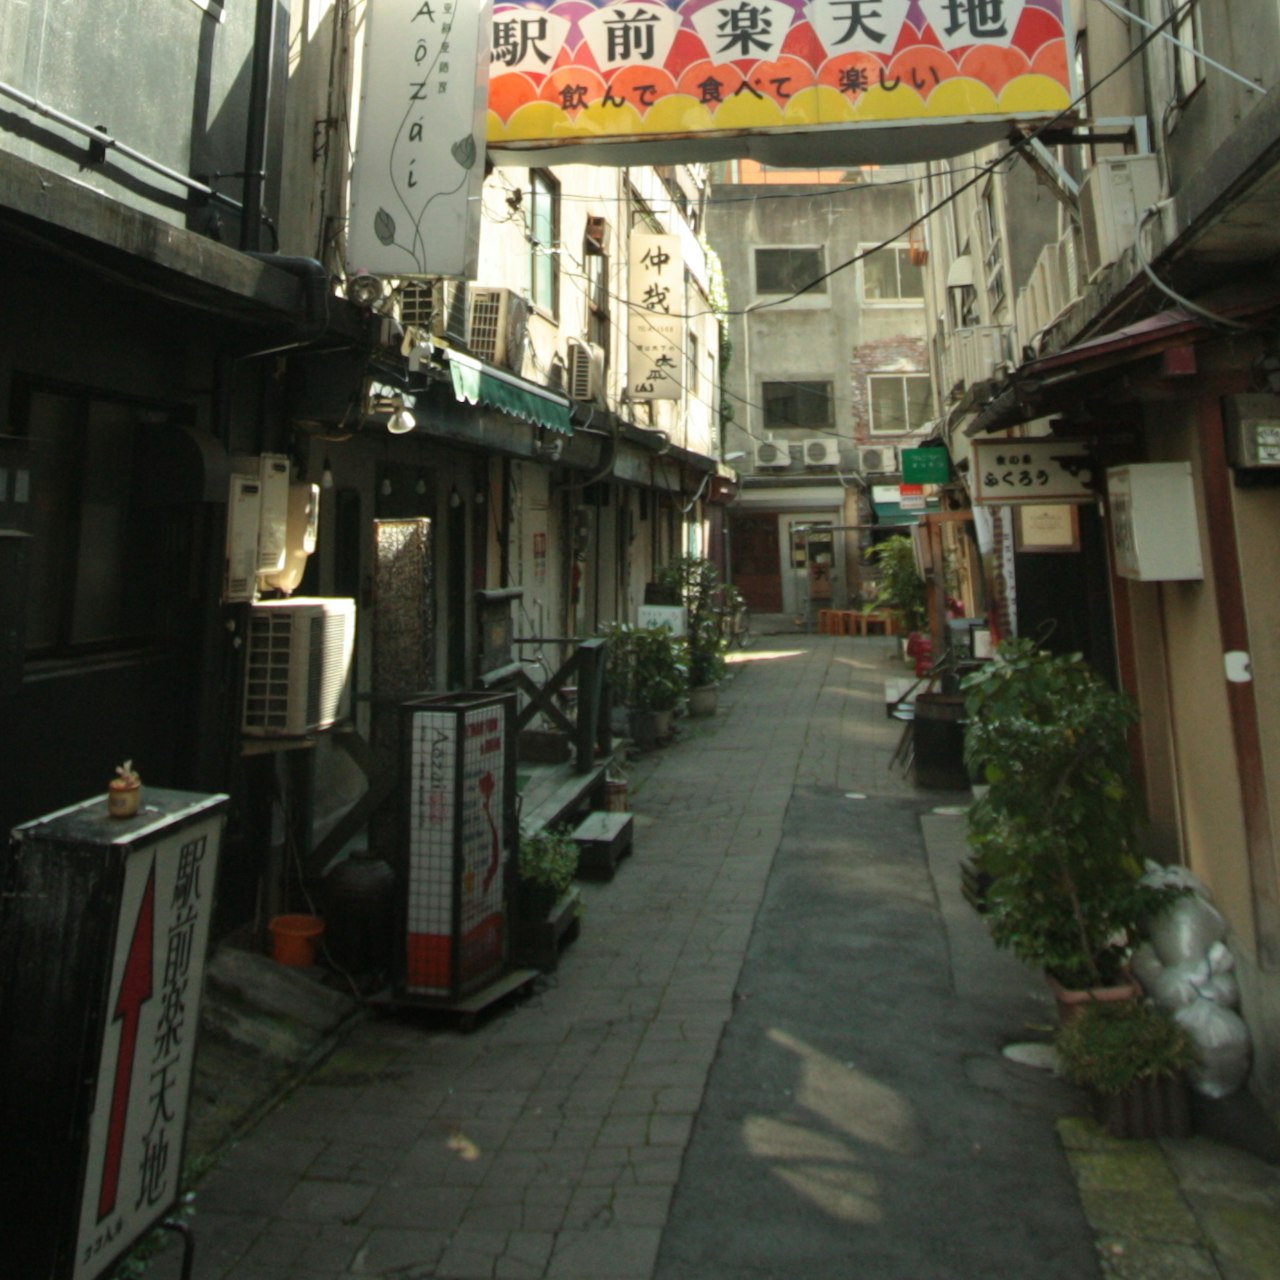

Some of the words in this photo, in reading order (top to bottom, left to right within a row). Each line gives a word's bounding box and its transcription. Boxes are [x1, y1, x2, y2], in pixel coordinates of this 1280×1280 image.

[558, 83, 658, 111] 飲んで
[696, 75, 792, 104] 食べて
[838, 66, 941, 95] 楽しい
[983, 470, 1050, 488] ふくろう
[135, 834, 208, 1212] 駅前楽天地
